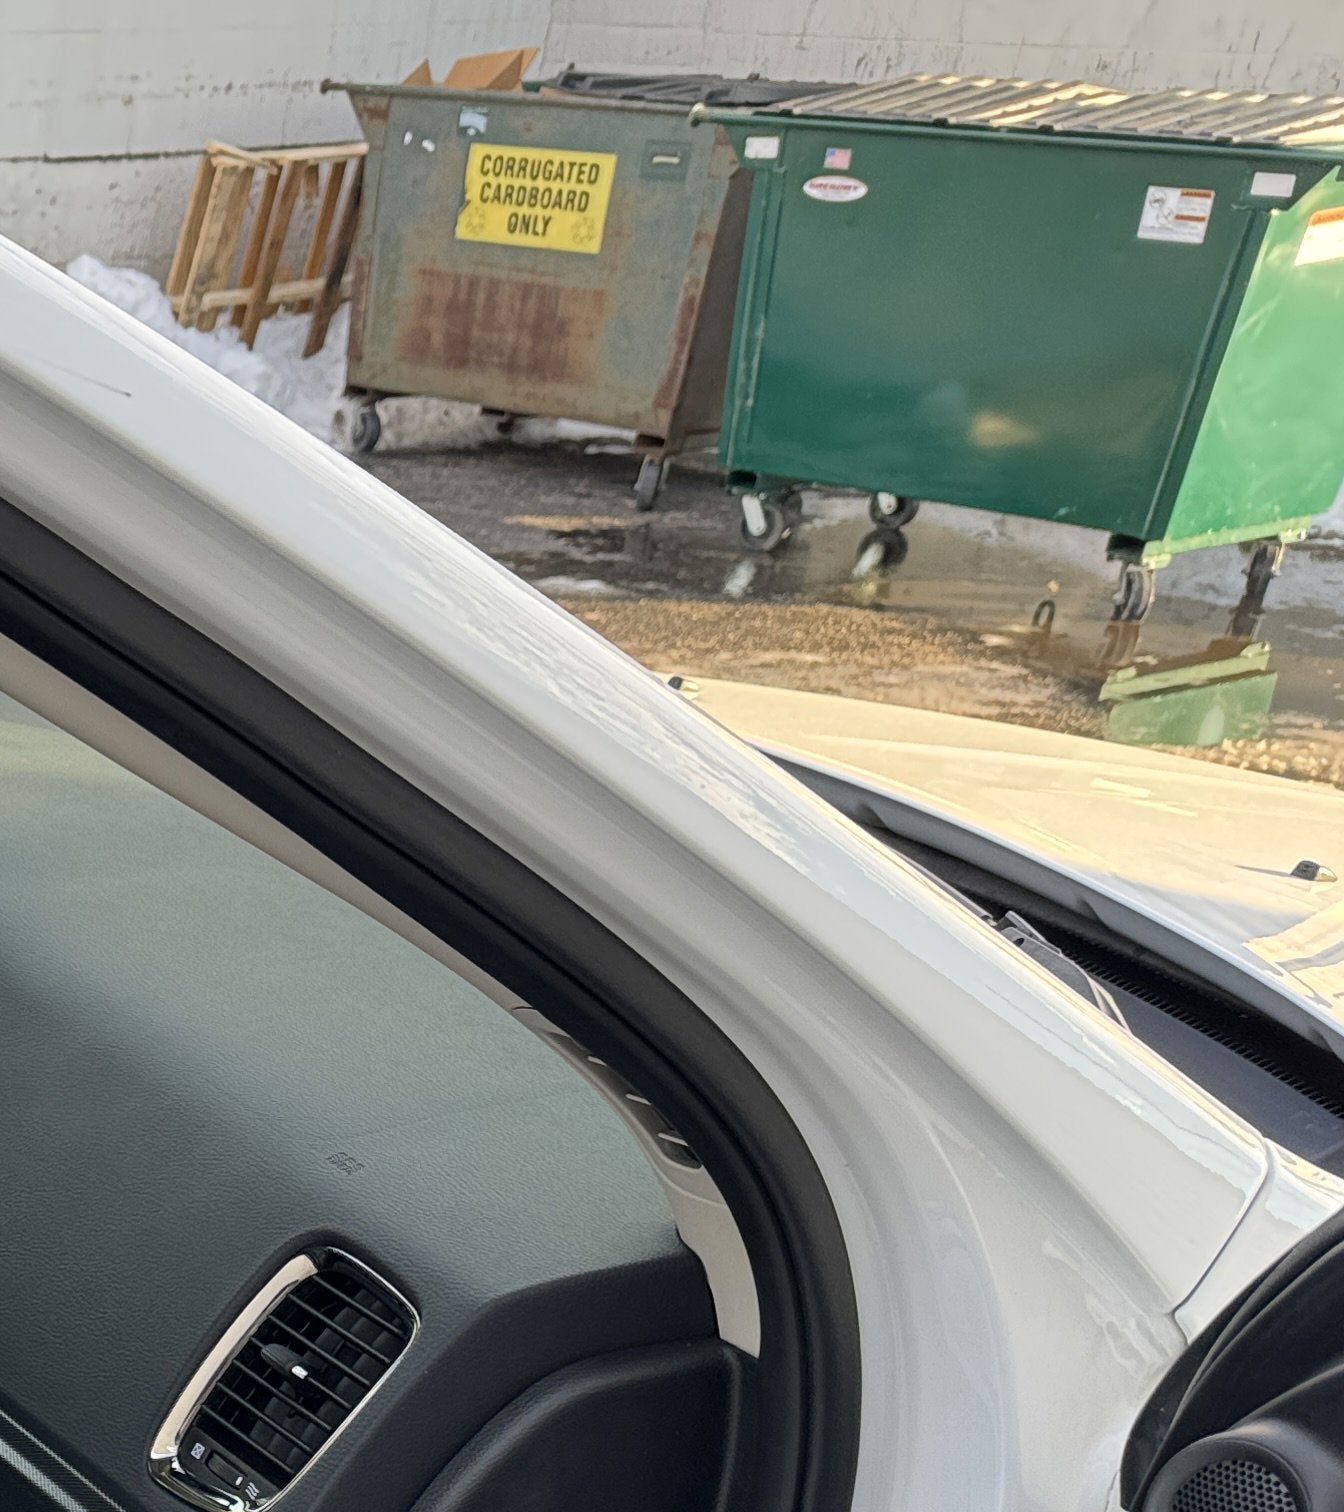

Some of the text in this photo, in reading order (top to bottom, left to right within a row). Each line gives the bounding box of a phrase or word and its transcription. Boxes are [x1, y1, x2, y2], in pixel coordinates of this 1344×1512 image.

[480, 154, 600, 185] CORRUGATED
[479, 182, 590, 213] CARDBOARD
[507, 213, 552, 237] ONLY
